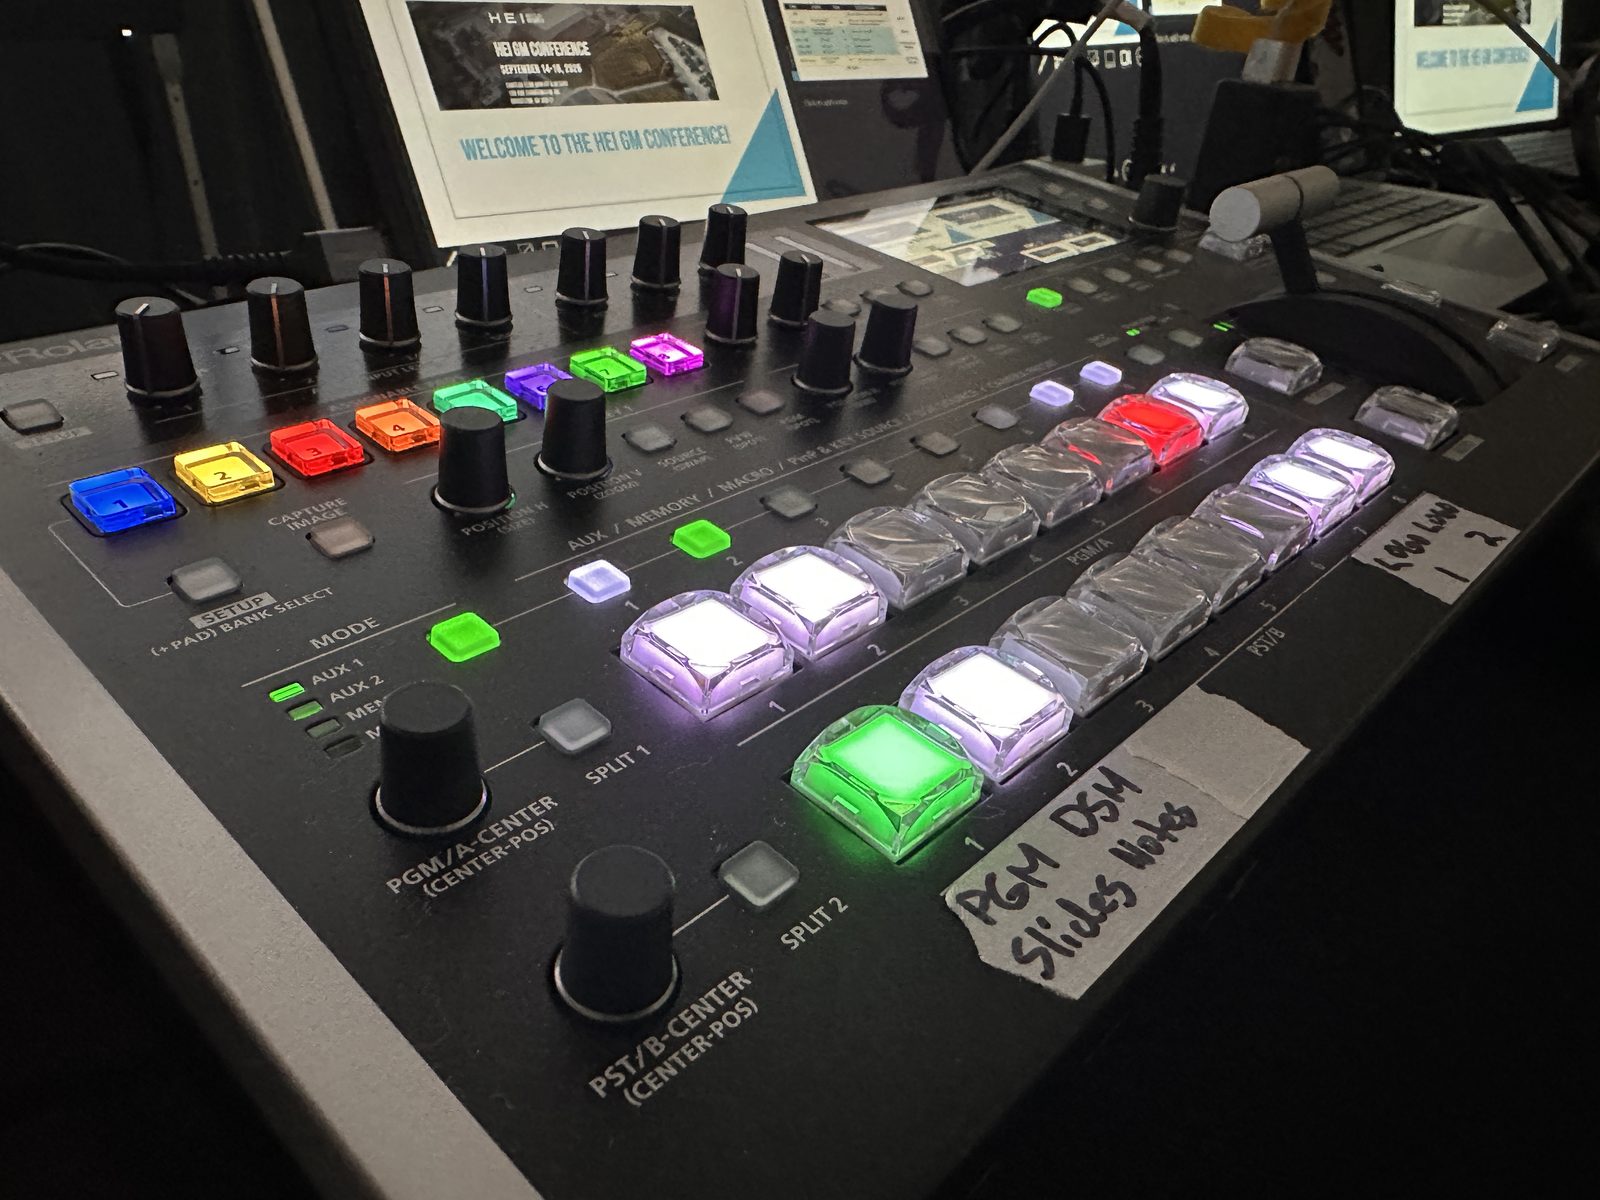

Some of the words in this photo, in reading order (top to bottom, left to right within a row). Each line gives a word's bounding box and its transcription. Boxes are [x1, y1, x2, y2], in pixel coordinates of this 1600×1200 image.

[493, 41, 513, 57] HEI
[512, 41, 530, 56] GM
[529, 41, 591, 56] CONFERENCE
[459, 133, 541, 161] WELCOME
[539, 134, 561, 155] TO
[561, 131, 594, 154] THE
[593, 129, 620, 152] HEI
[618, 129, 643, 150] GM
[642, 124, 731, 150] CONFERENCE!
[392, 424, 406, 433] 4
[305, 447, 320, 457] 3
[213, 471, 232, 481] 2
[566, 472, 631, 500] POSITION
[112, 499, 129, 509] 1
[268, 498, 347, 527] CAPTURE
[567, 529, 609, 551] AUX
[624, 493, 701, 528] MEMORY
[717, 467, 775, 492] MACRO
[287, 509, 347, 531] IMAGE
[461, 506, 531, 537] POSITION
[535, 501, 549, 511] H
[726, 556, 744, 567] 2
[1066, 537, 1114, 566] PGM/A
[171, 628, 218, 651] PAD)
[219, 609, 273, 633] BANK
[274, 587, 334, 614] SELECT
[203, 597, 265, 624] SETUP
[624, 600, 640, 611] 1
[309, 617, 381, 649] MODE
[1247, 626, 1286, 658] PST/B
[867, 643, 887, 657] 2
[1202, 646, 1221, 658] 4
[312, 663, 351, 685] AUX
[351, 657, 365, 668] 1
[329, 680, 370, 703] AUX
[369, 675, 385, 687] 2
[768, 700, 786, 712] 1
[1135, 700, 1155, 713] 3
[585, 751, 636, 785] SPLIT
[636, 743, 652, 757] 1
[1056, 762, 1079, 777] 2
[385, 795, 559, 894] PGM/A-CENTER
[422, 818, 555, 897] (CENTER-POS)
[955, 842, 1060, 926] PGM
[1049, 765, 1143, 838] DSM
[965, 836, 985, 852] 1
[780, 905, 833, 950] SPLIT
[828, 896, 849, 913] 2
[1011, 874, 1137, 981] Slides
[588, 971, 752, 1098] PST/B-CENTER
[623, 997, 759, 1107] (CENTER-POS)
